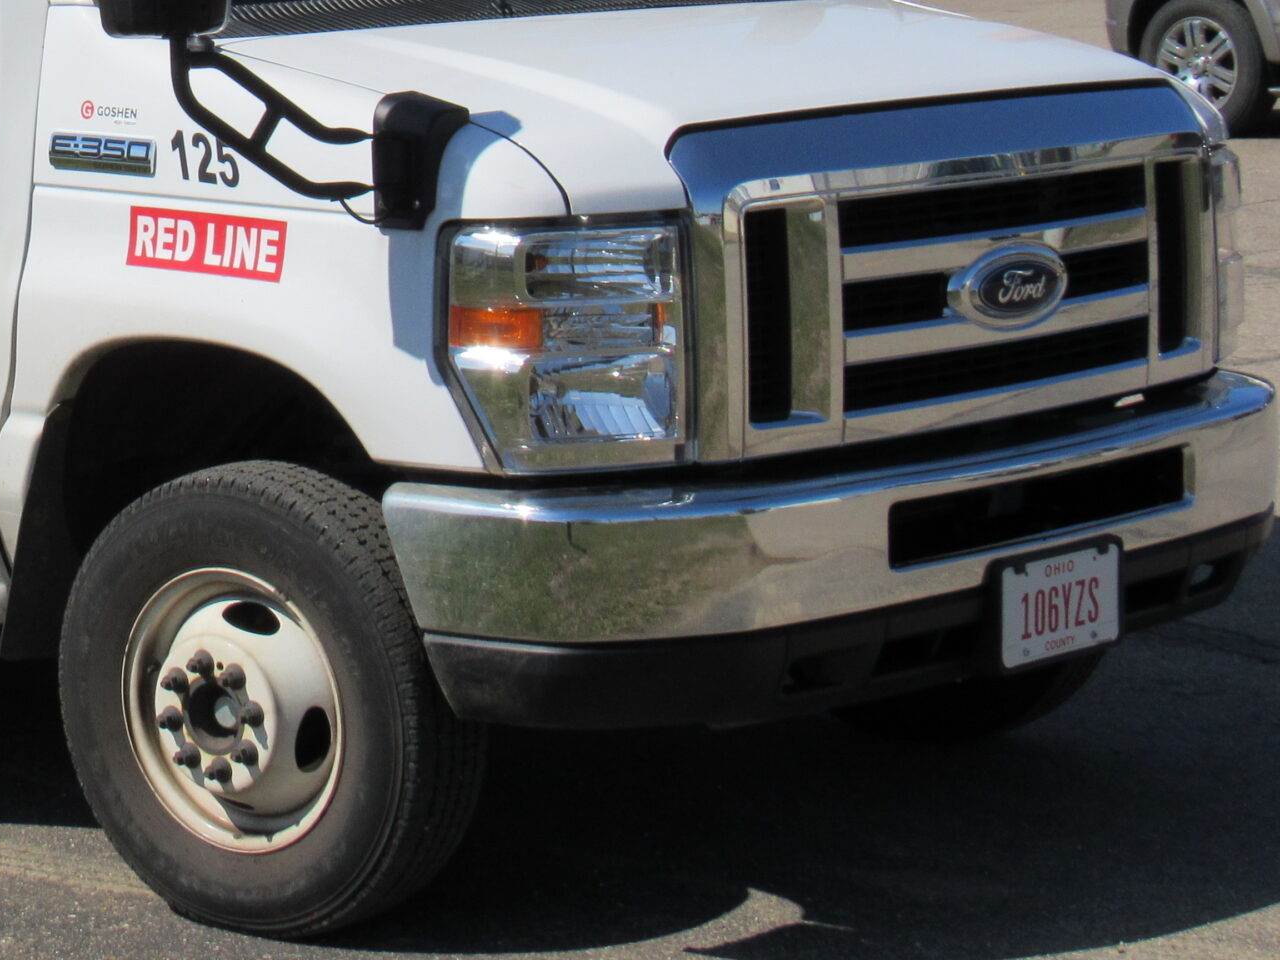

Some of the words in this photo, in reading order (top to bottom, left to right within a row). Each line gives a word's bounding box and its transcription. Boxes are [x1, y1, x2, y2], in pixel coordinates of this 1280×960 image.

[97, 105, 138, 119] GOSHEN
[171, 129, 240, 188] 125
[134, 214, 196, 262] RED
[203, 222, 280, 273] LINE
[998, 268, 1047, 304] Ford
[1044, 559, 1075, 578] OHIO
[1020, 576, 1100, 641] 106YZS
[1044, 635, 1076, 652] COUNTY
